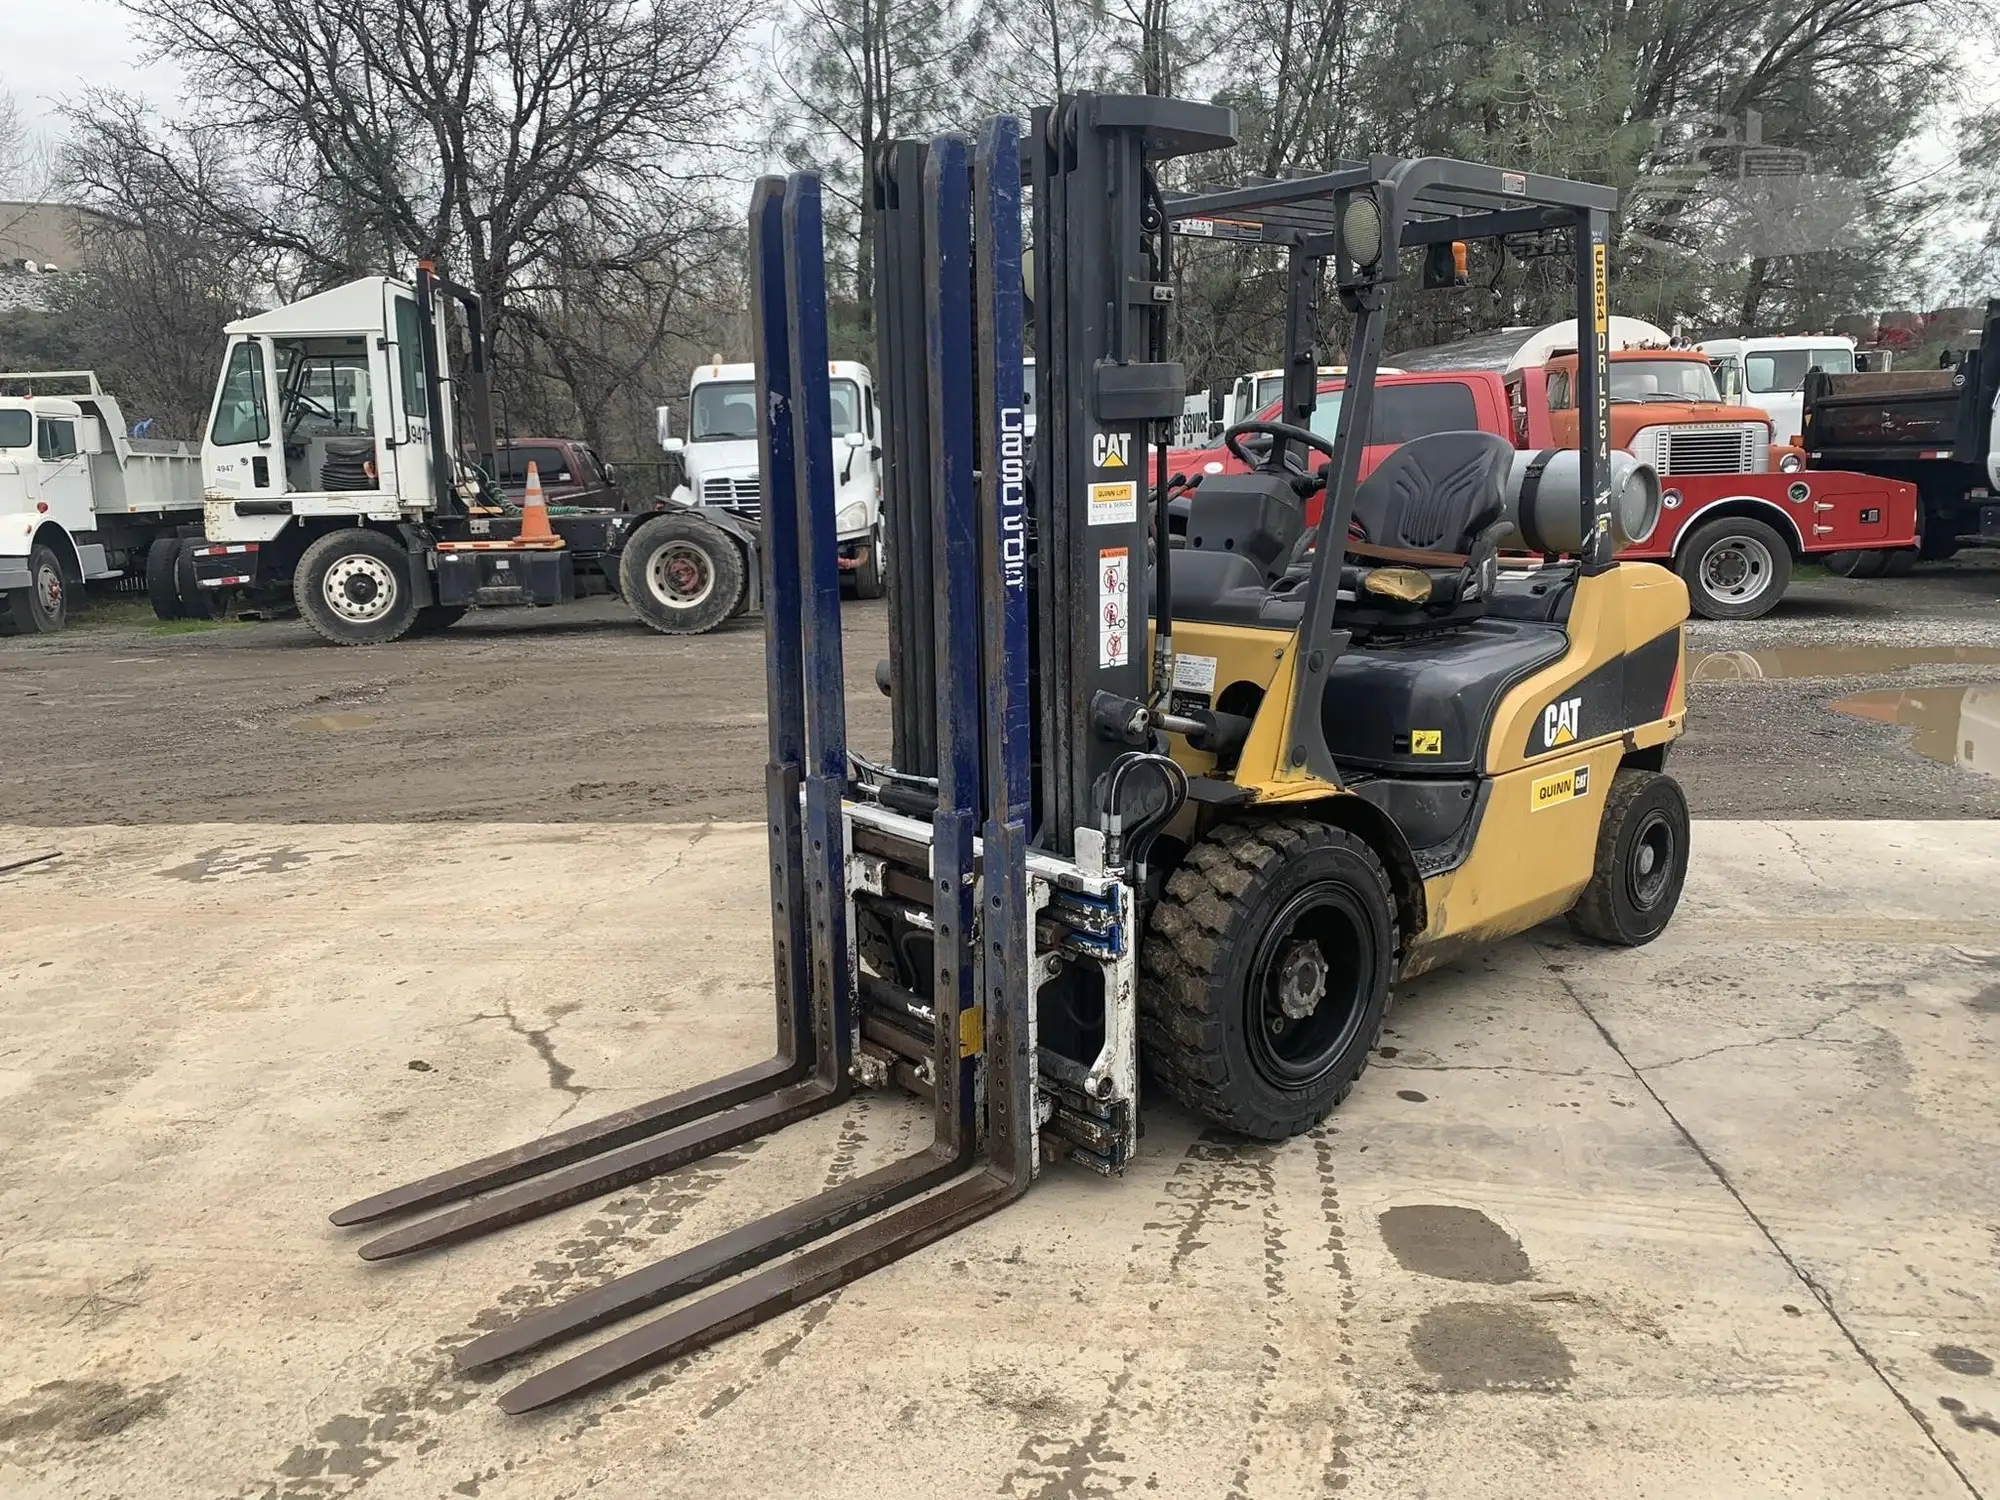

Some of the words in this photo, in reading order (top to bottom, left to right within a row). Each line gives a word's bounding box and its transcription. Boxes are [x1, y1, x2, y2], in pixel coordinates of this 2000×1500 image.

[1595, 251, 1606, 321] U8654
[1597, 334, 1607, 460] DRLP54
[1092, 433, 1131, 467] CAT
[216, 464, 234, 473] 4947
[1097, 490, 1115, 498] QUINN
[1544, 697, 1582, 747] CAT
[1539, 779, 1572, 800] QUINN
[1575, 773, 1587, 789] CAT
